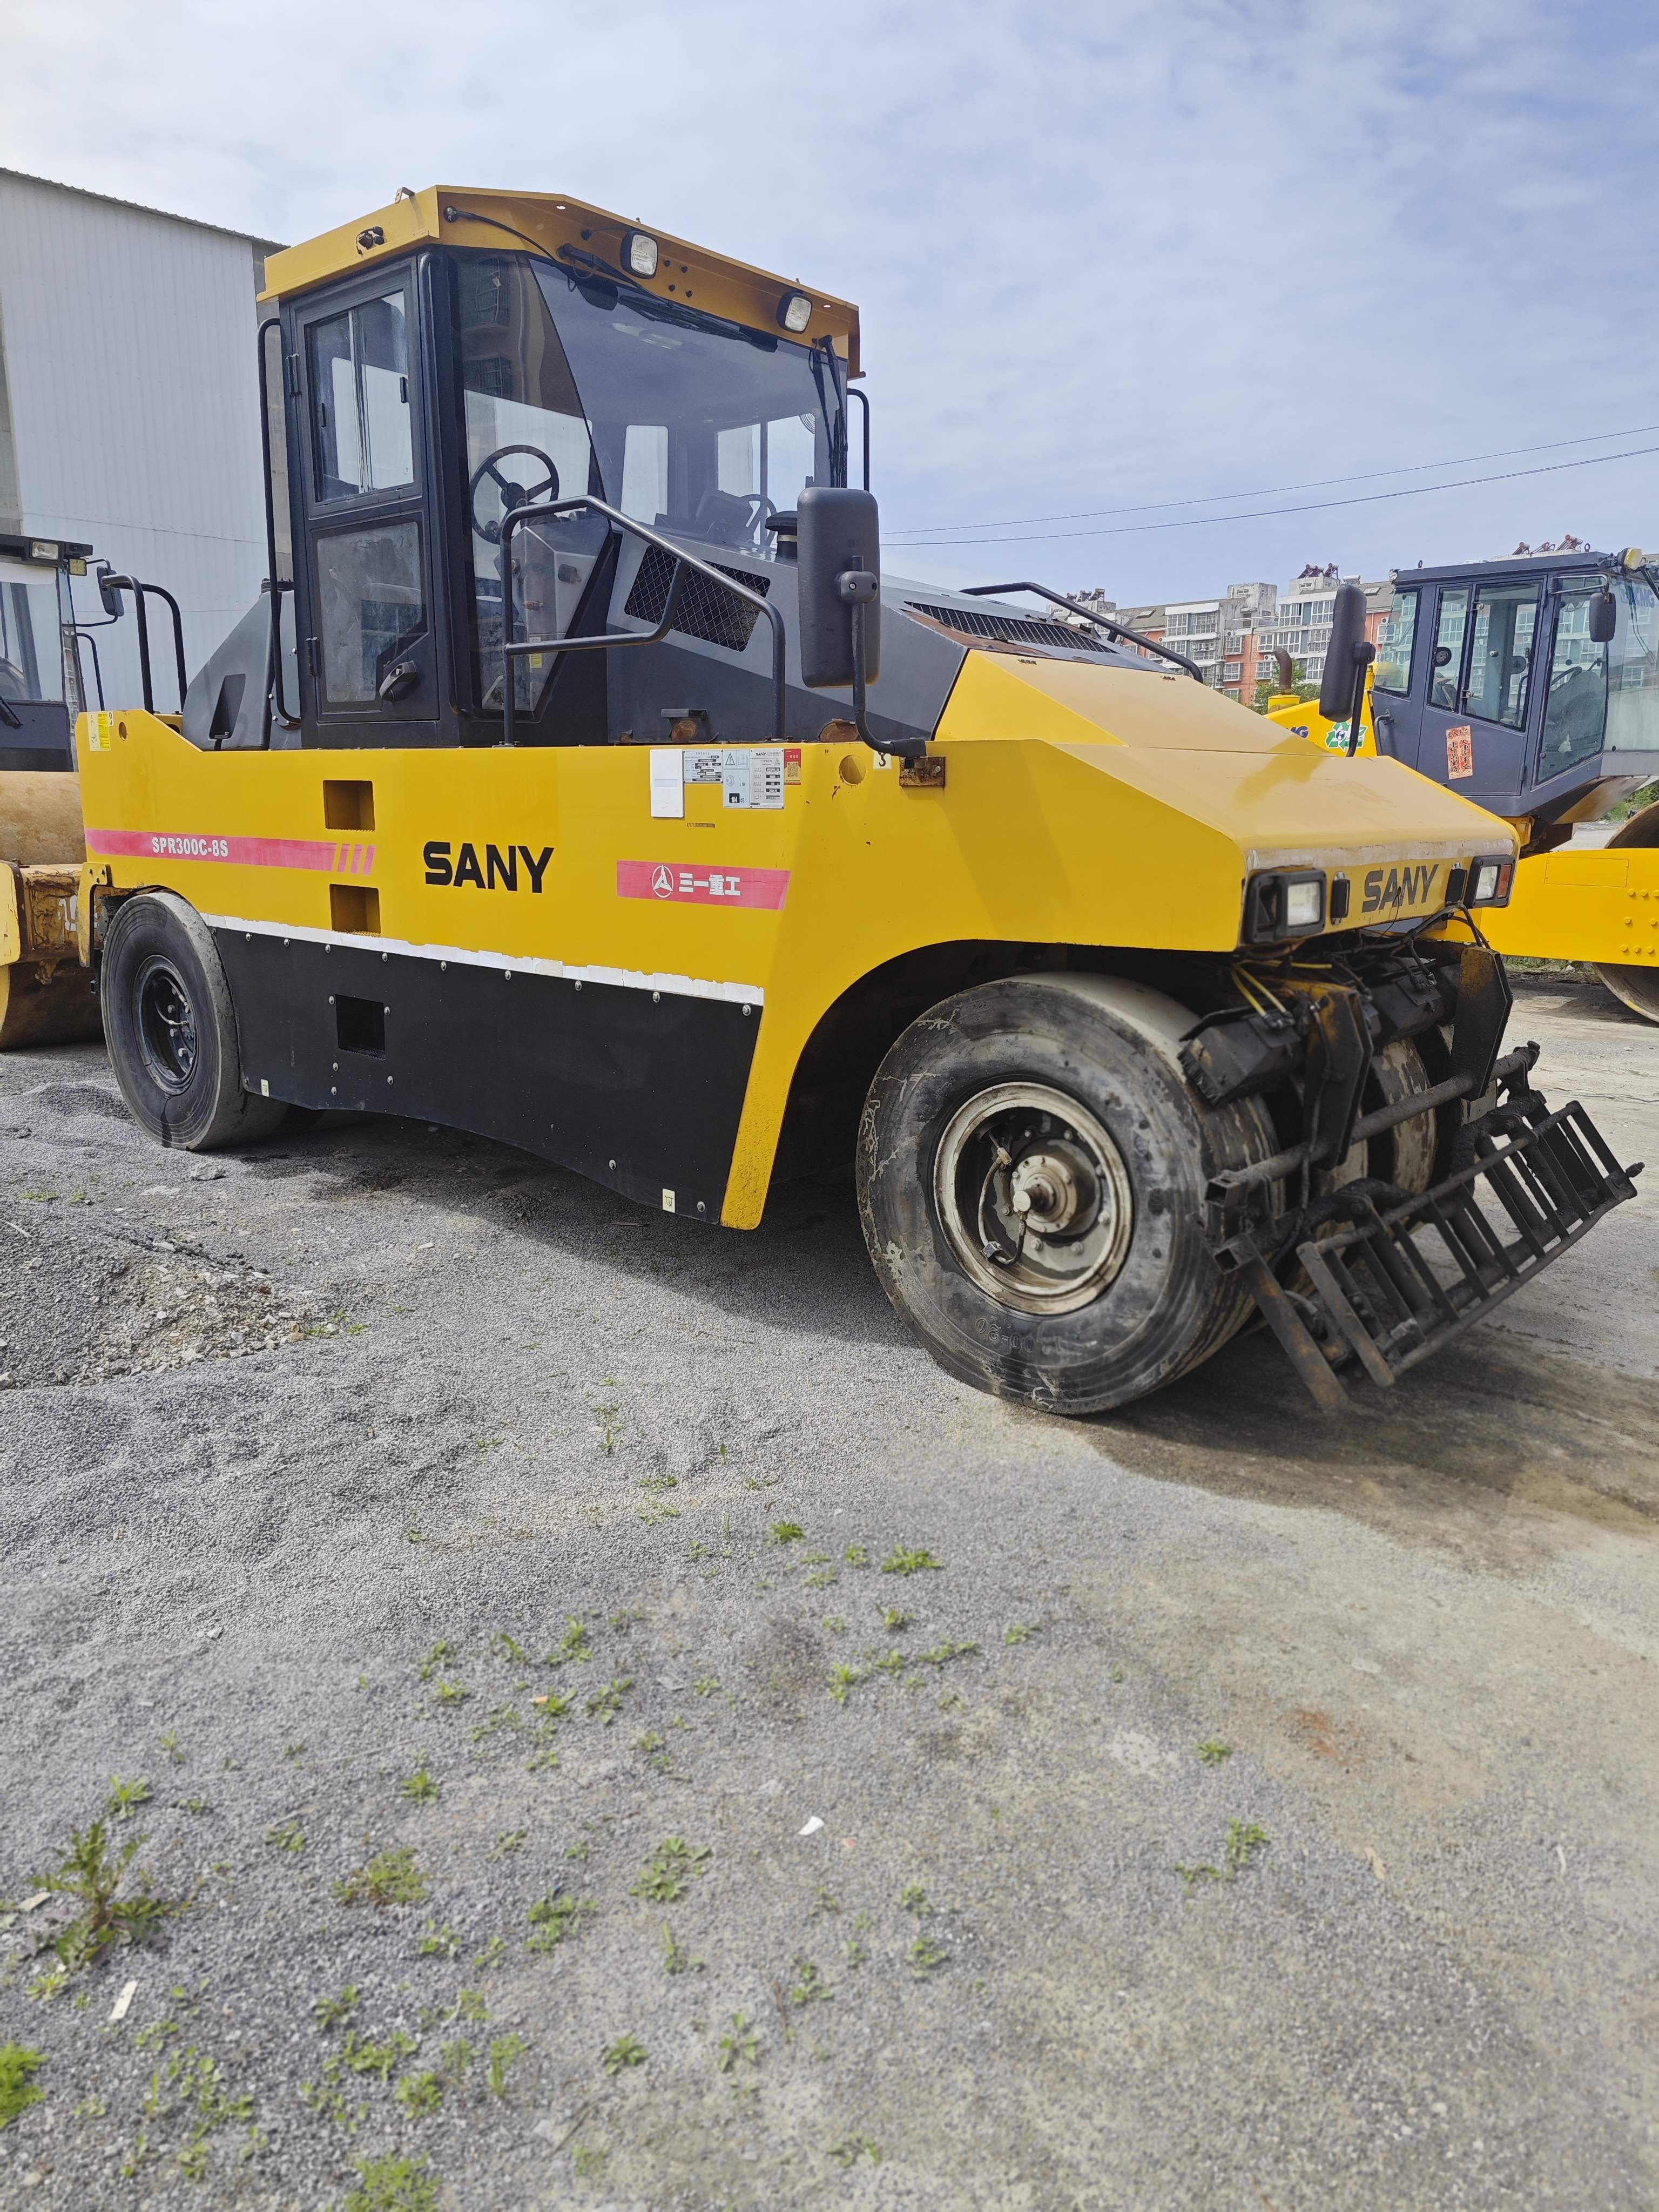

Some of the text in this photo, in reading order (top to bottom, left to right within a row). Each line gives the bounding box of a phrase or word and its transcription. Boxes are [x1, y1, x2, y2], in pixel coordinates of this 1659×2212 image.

[152, 837, 228, 857] SPR300C-8S
[423, 841, 555, 893] SANY
[679, 873, 741, 895] 三一重工
[1361, 864, 1439, 913] SANY
